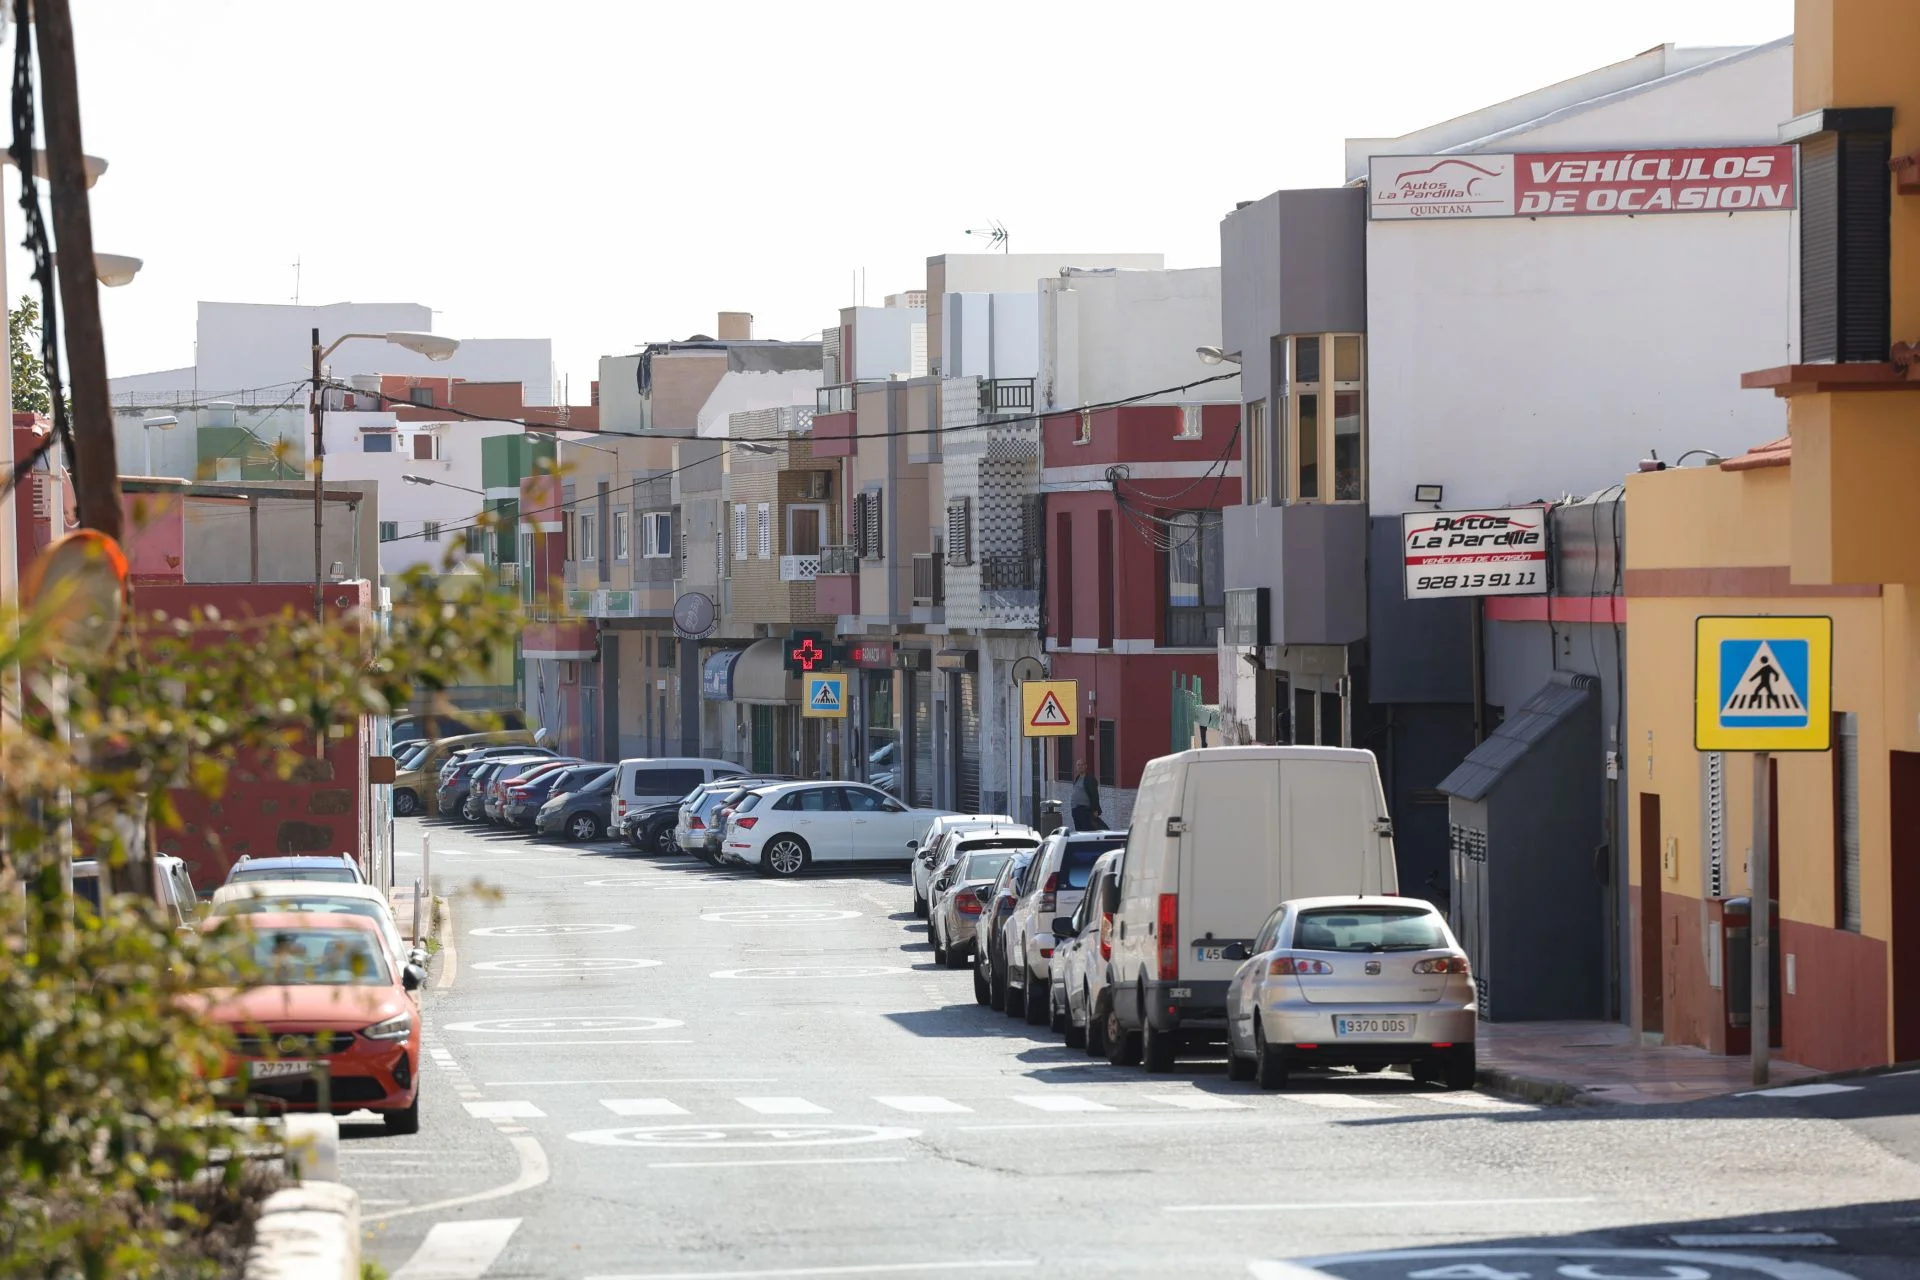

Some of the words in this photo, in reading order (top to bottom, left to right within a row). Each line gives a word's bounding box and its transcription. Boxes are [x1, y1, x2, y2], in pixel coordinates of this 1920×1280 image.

[1530, 154, 1775, 183] VEHÍCULOS
[1400, 181, 1448, 190] Autos
[1378, 191, 1397, 200] La
[1403, 189, 1465, 199] Pardilla
[1519, 190, 1580, 213] DE
[1586, 184, 1788, 211] OCASION
[1410, 204, 1473, 216] QUINTANA
[1411, 535, 1442, 549] La
[1448, 531, 1539, 548] Pardilla
[1417, 575, 1457, 590] 928
[1460, 575, 1485, 588] 13
[1488, 573, 1510, 587] 91
[1516, 572, 1535, 586] 11
[1347, 1020, 1378, 1032] 9370
[1382, 1020, 1405, 1032] DDS
